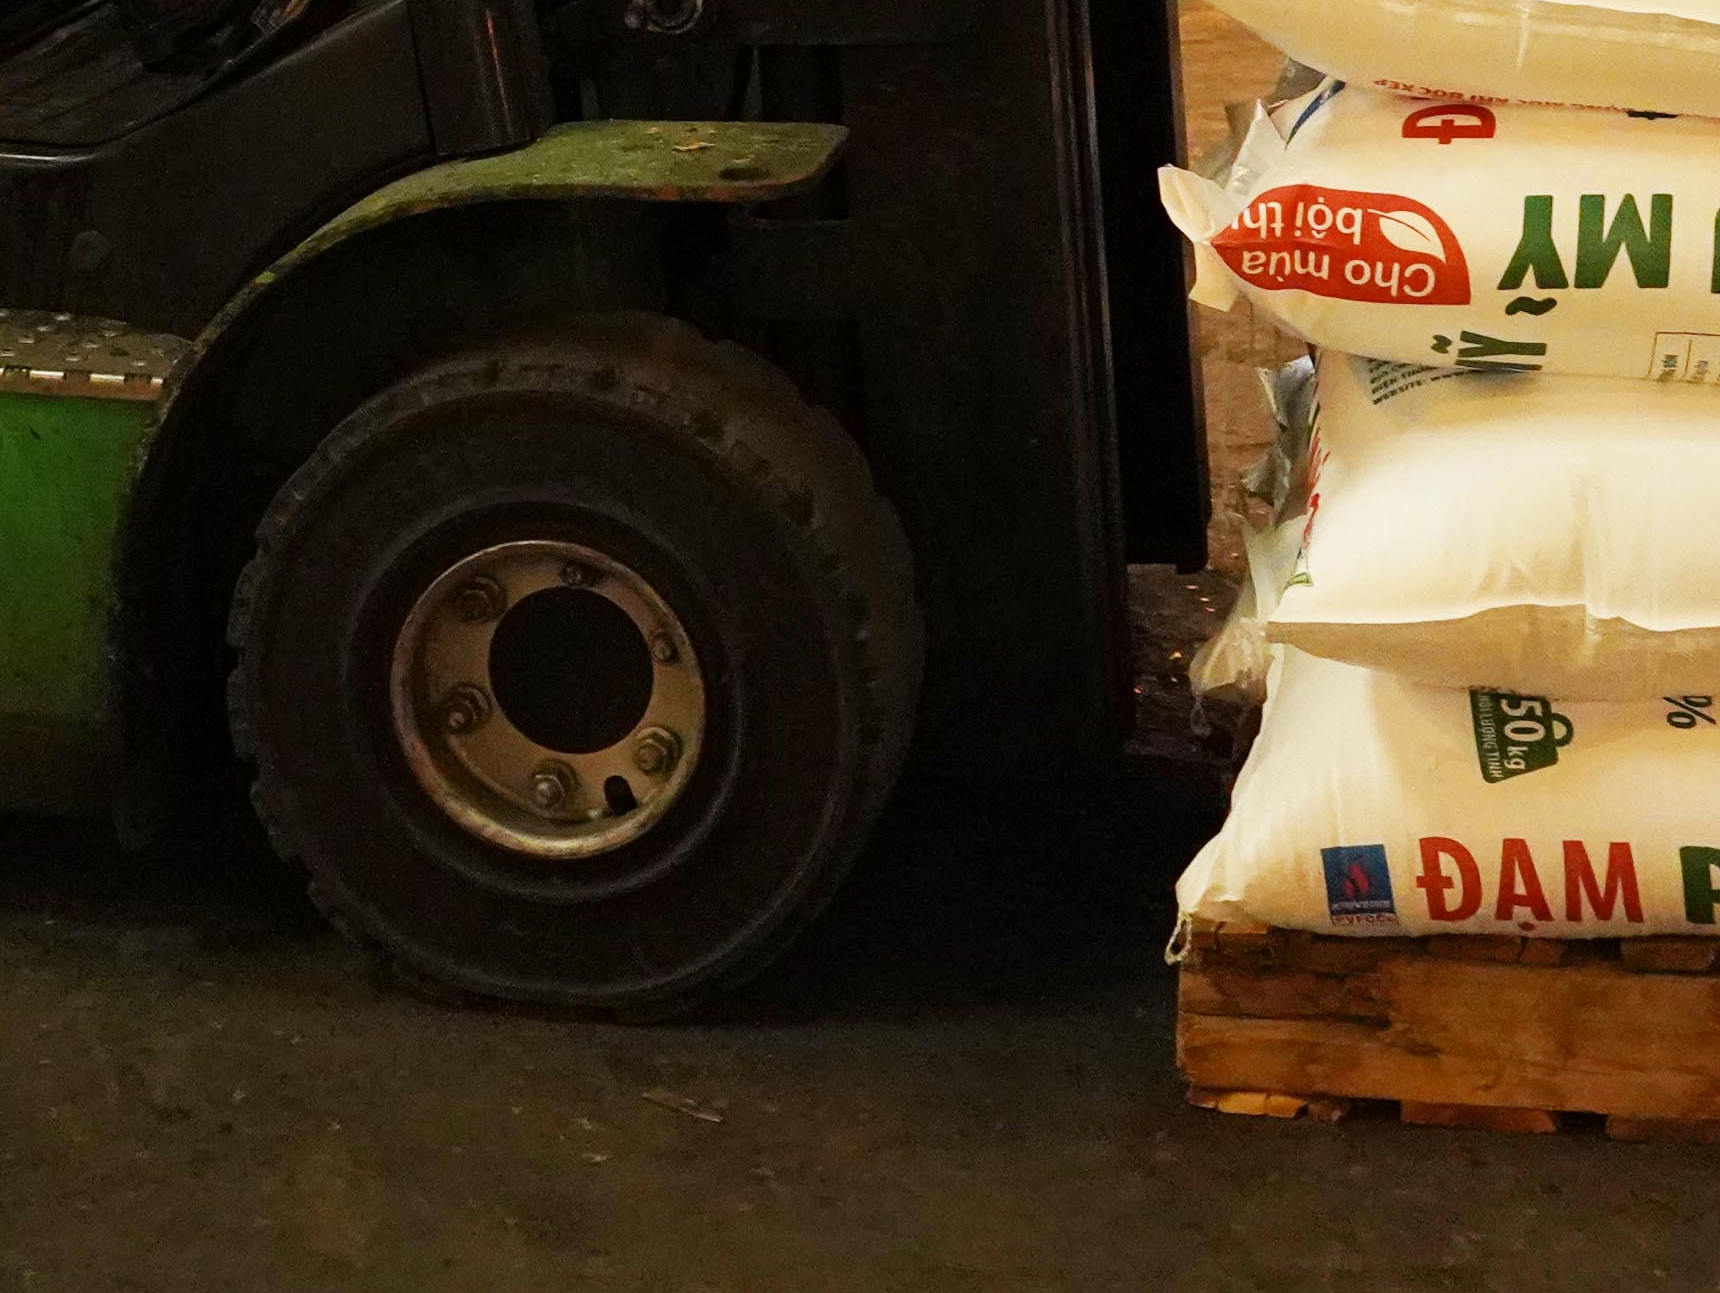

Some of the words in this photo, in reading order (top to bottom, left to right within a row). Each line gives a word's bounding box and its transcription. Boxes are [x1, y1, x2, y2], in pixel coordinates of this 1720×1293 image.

[1294, 200, 1365, 244] bội
[1241, 247, 1330, 282] mùa
[1496, 193, 1673, 317] MỸ
[1345, 259, 1436, 297] Cho
[1498, 694, 1545, 747] 50
[1501, 747, 1530, 772] kg
[1412, 836, 1648, 935] ĐẠM
